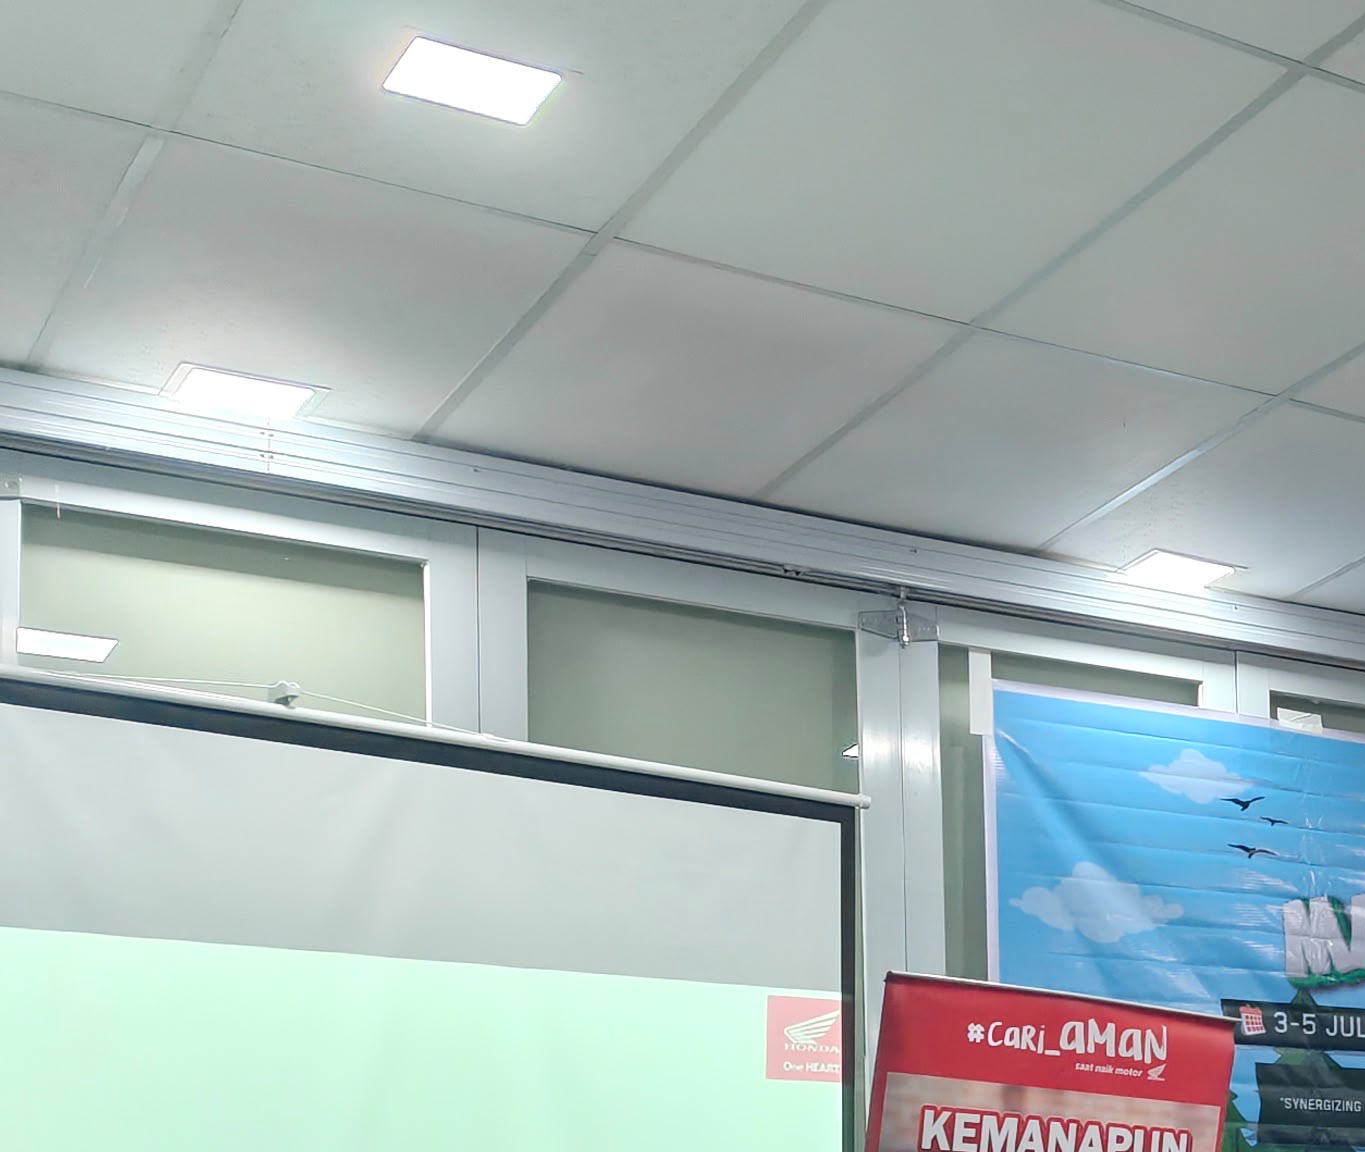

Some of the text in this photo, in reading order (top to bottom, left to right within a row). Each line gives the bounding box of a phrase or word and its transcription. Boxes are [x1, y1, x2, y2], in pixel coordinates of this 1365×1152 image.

[1274, 1011, 1317, 1036] 3-5
[784, 1043, 839, 1054] HONDA
[1095, 1064, 1114, 1074] naik
[1115, 1067, 1143, 1077] motor
